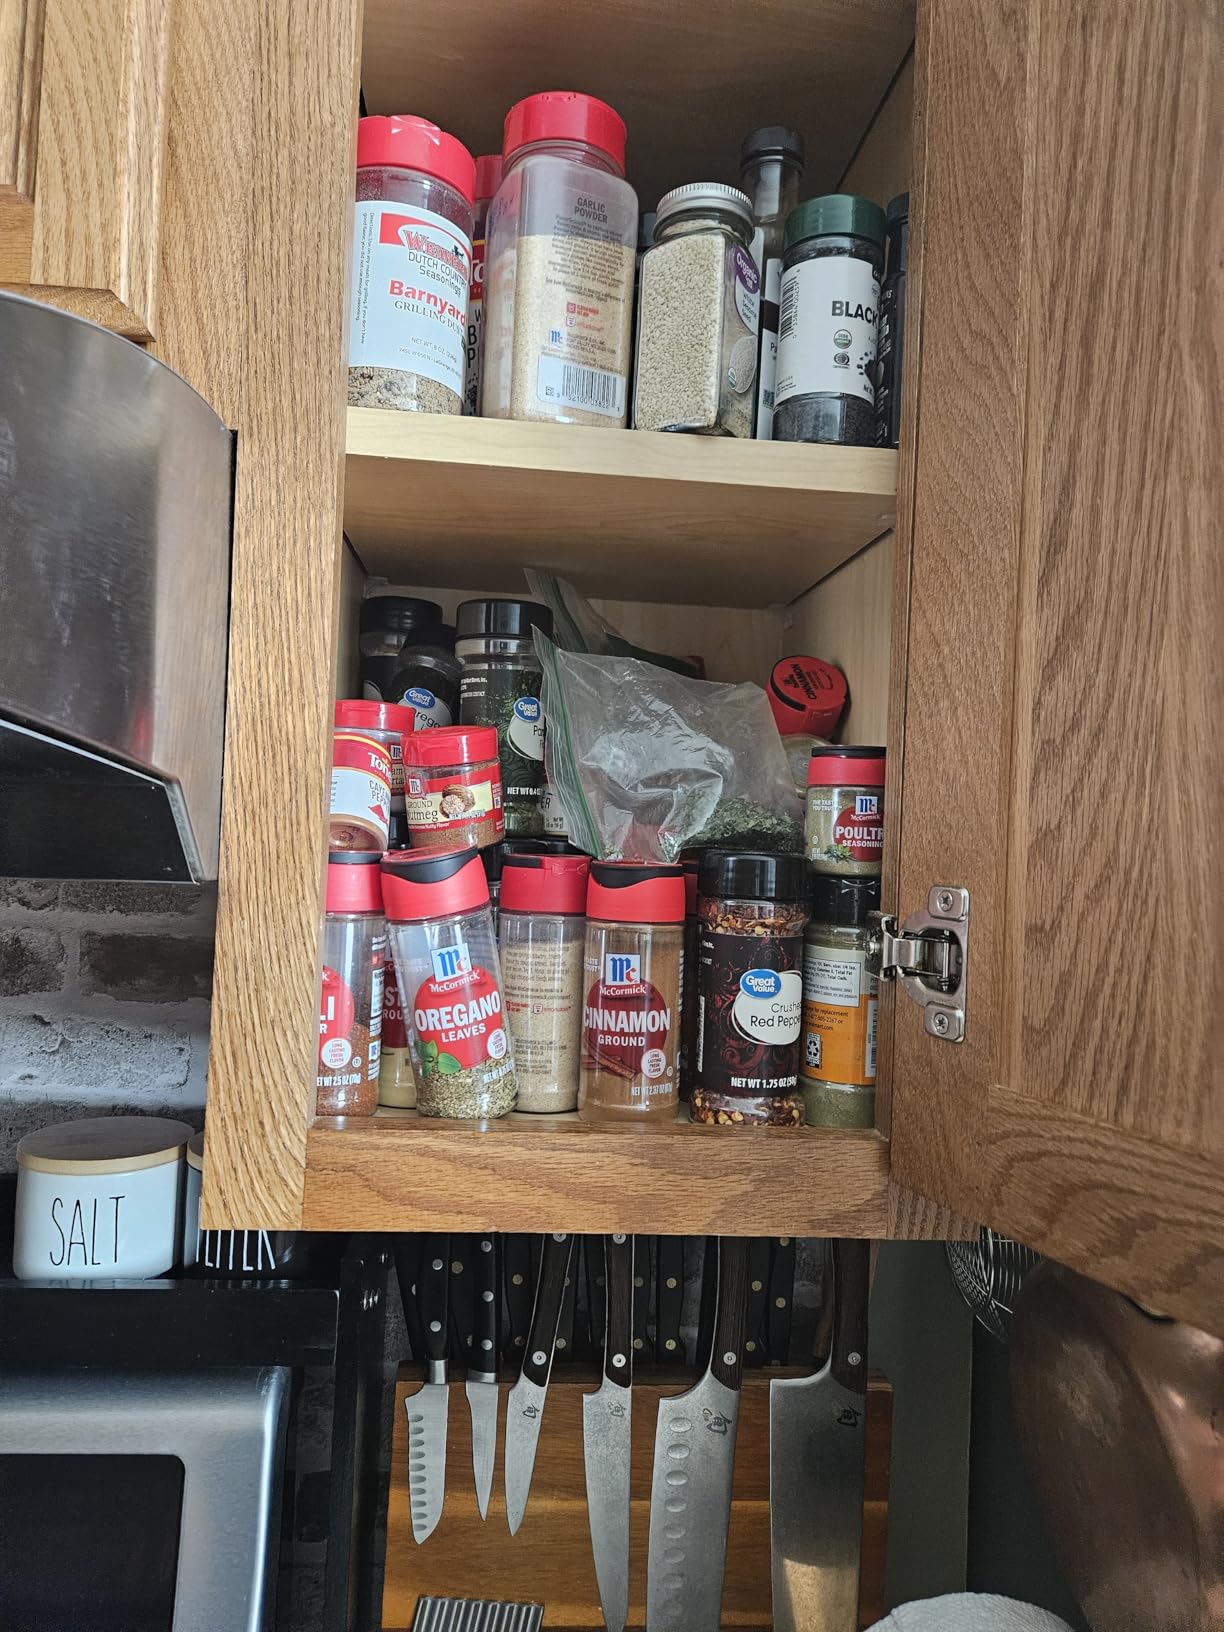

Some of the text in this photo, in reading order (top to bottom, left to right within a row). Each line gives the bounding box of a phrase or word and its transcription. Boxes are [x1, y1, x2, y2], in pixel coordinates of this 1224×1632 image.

[577, 197, 606, 213] GARLIC
[574, 206, 608, 224] POWDER
[408, 251, 438, 271] DUTCH
[736, 252, 758, 284] Organic
[389, 280, 466, 326] Barnyard
[394, 300, 446, 324] GRILLING
[831, 300, 878, 327] BLACK
[408, 690, 432, 703] Great
[518, 701, 538, 712] Great
[507, 786, 519, 795] NET
[429, 970, 480, 993] McCormick
[746, 975, 776, 987] Great
[600, 985, 648, 996] McCormick
[753, 984, 776, 993] Value
[414, 991, 501, 1032] OREGANO
[771, 1003, 801, 1013] Crushe
[820, 1008, 849, 1017] replacement
[584, 1007, 671, 1033] CINNAMON
[750, 1015, 801, 1029] Red Peppe
[441, 1023, 487, 1043] LEAVES
[598, 1035, 645, 1047] GROUND
[316, 1077, 324, 1087] ET
[324, 1076, 333, 1087] WT
[333, 1076, 342, 1086] 2.5
[342, 1075, 350, 1085] OZ
[731, 1077, 746, 1087] NET
[747, 1077, 760, 1088] WT
[762, 1079, 778, 1089] 1.75
[778, 1078, 787, 1087] OZ
[631, 1086, 641, 1096] NET
[48, 1194, 126, 1268] SALT
